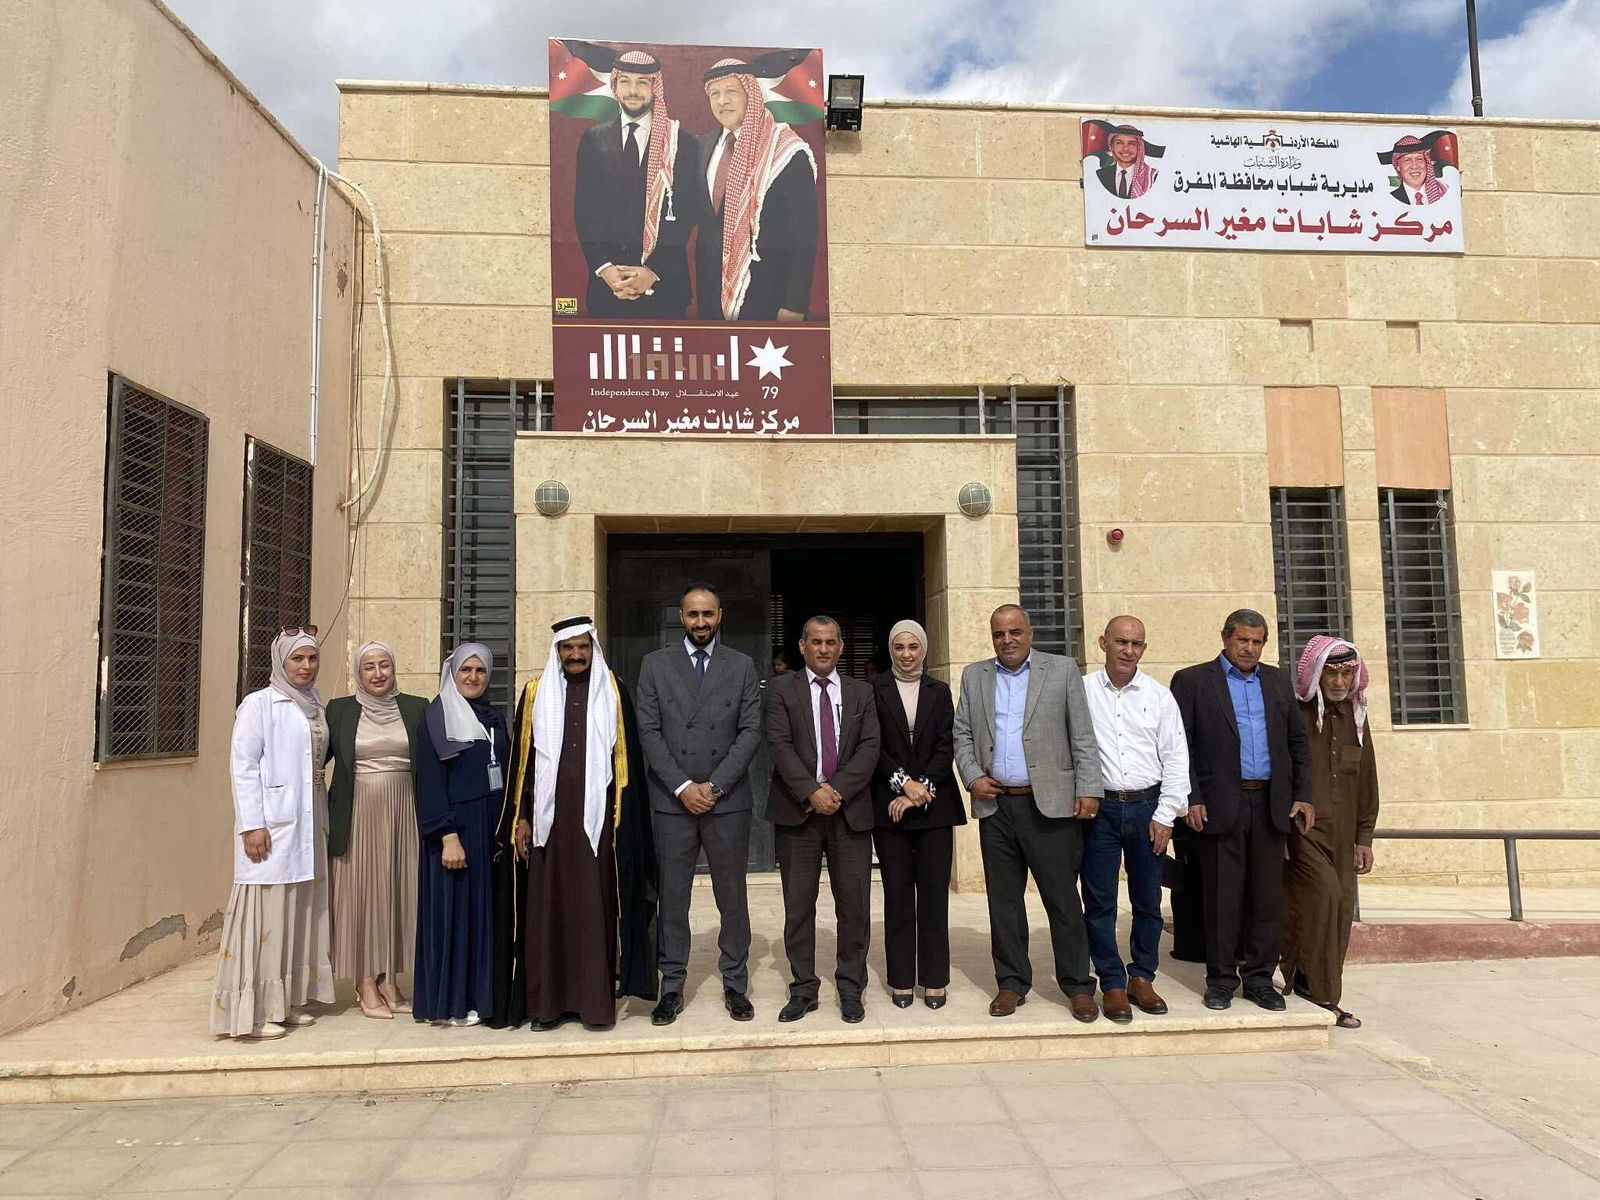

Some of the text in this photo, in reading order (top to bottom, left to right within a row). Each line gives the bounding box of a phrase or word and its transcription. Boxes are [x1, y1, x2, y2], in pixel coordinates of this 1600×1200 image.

[1210, 134, 1242, 149] الهاشمية
[1310, 137, 1340, 150] المملكة
[1173, 170, 1374, 198] مديرية شباب محافظة المفرق
[1106, 204, 1453, 243] مركز شابات مغير السرحان
[590, 388, 670, 398] Independence Day
[675, 389, 740, 399] عيد الاستقلال
[761, 386, 779, 400] 79
[582, 407, 800, 435] مركز شابات مغير السرحان
